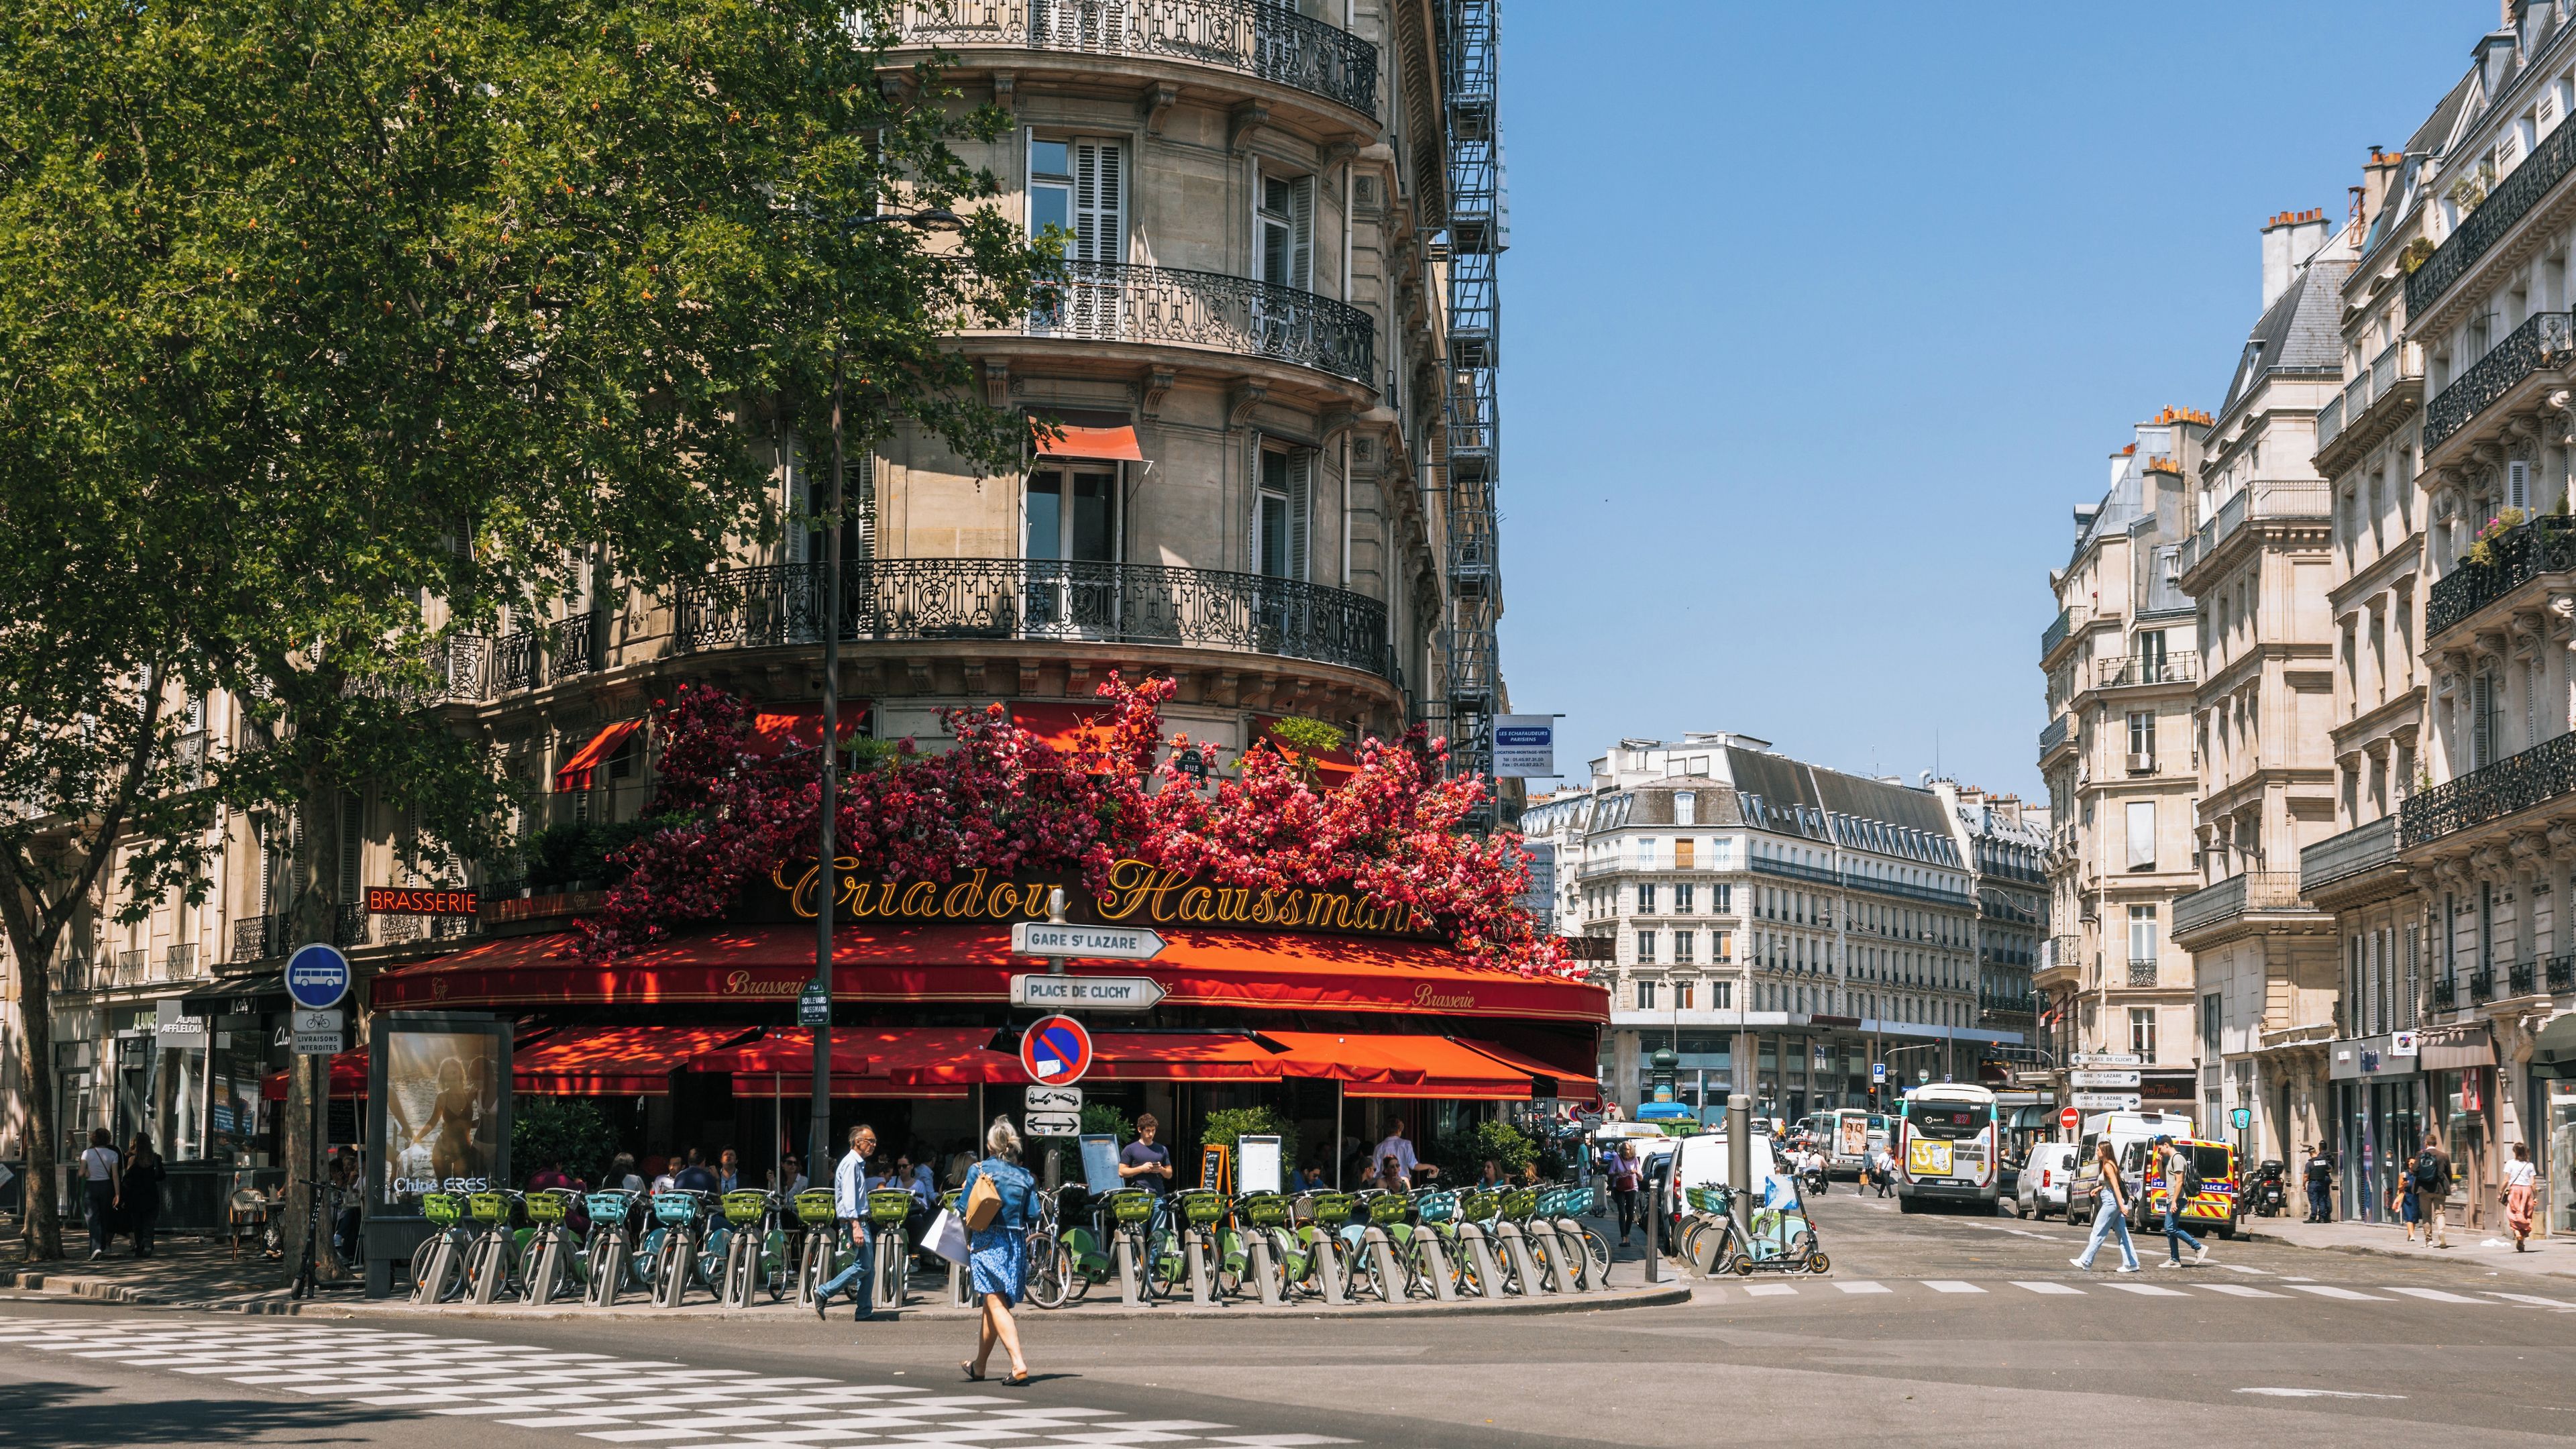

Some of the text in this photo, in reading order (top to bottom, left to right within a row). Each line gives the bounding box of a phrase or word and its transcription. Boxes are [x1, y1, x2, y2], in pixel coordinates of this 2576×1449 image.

[370, 890, 477, 913] BRASSERIE
[1097, 858, 1425, 933] Haussmann
[1031, 933, 1067, 946] GARE
[1087, 936, 1137, 949] LAZARE
[723, 970, 806, 994] Brasseri
[1030, 985, 1131, 998] PLACE DE CLICHY
[1411, 983, 1475, 1008] Brasserie
[802, 996, 827, 1004] BOULEVARD
[176, 1016, 202, 1024] ALAIN
[160, 1024, 202, 1034] AFFLELOU
[1955, 1114, 1969, 1124] 27
[393, 1177, 488, 1193] Chloé ERES
[2201, 1183, 2222, 1191] LICE
